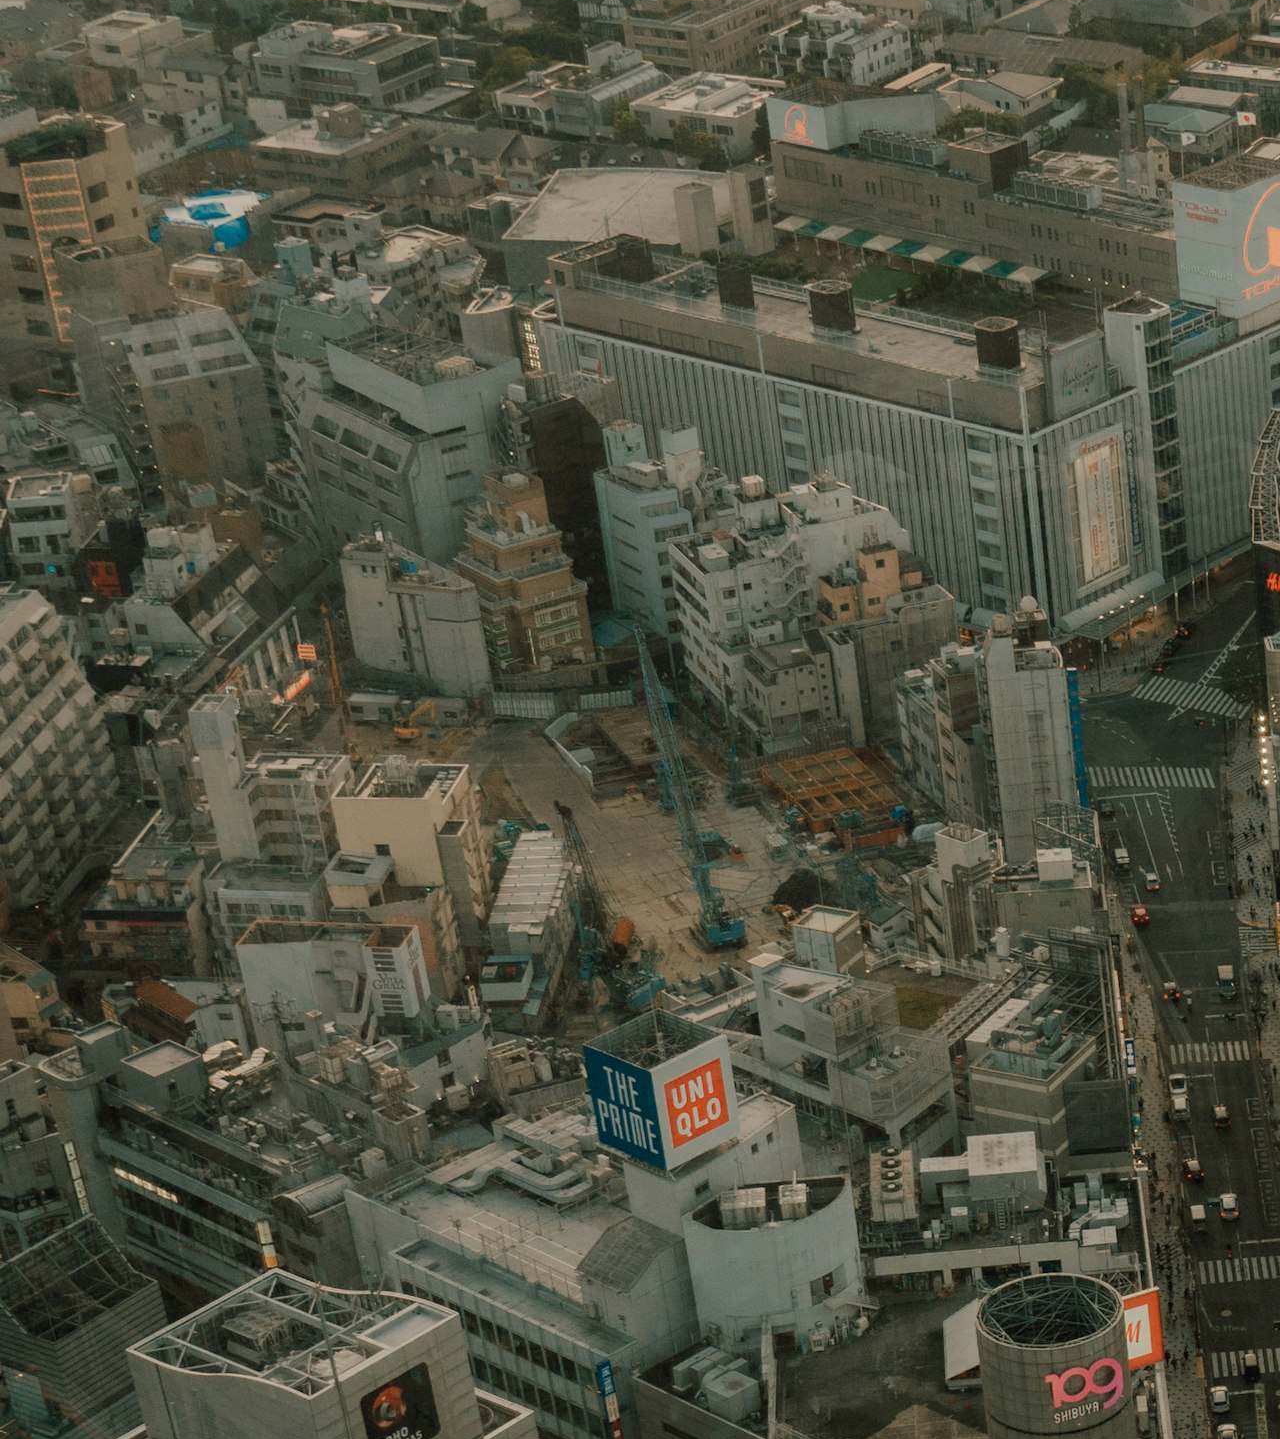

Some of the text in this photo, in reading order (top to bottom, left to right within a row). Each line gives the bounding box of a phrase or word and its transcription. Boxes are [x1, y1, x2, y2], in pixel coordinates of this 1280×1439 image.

[602, 1066, 642, 1112] THE
[671, 1071, 714, 1110] UNI
[597, 1098, 660, 1155] PRIME
[676, 1097, 722, 1137] QLO
[1044, 1357, 1125, 1410] 109
[1053, 1401, 1100, 1424] SHIBUYA
